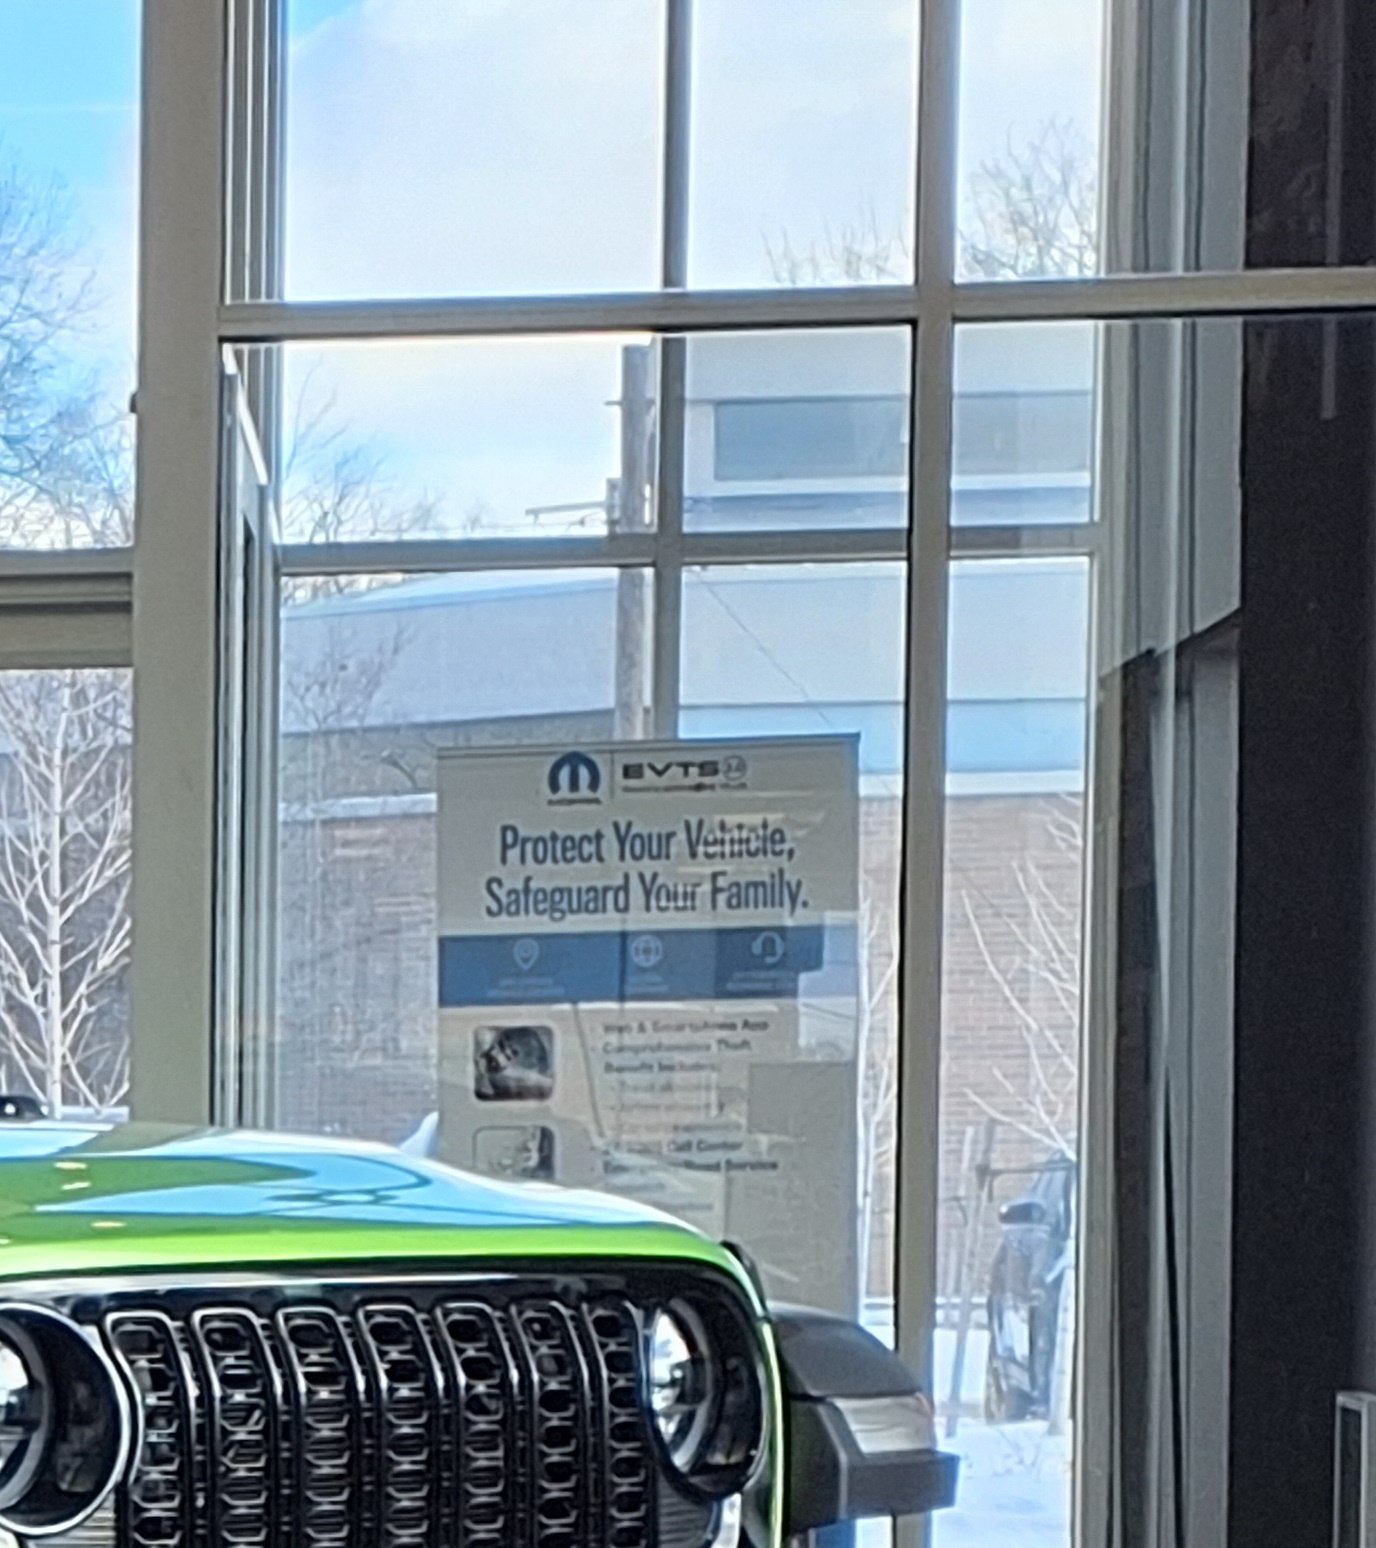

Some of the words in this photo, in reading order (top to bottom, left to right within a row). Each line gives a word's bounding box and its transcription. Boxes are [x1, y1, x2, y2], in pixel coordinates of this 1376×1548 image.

[622, 760, 719, 779] EVTS
[500, 824, 605, 866] Protect
[613, 820, 677, 863] Your
[684, 817, 796, 862] Vehicle,
[485, 872, 631, 921] Safeguard
[638, 871, 702, 912] Your
[711, 867, 809, 917] Family.
